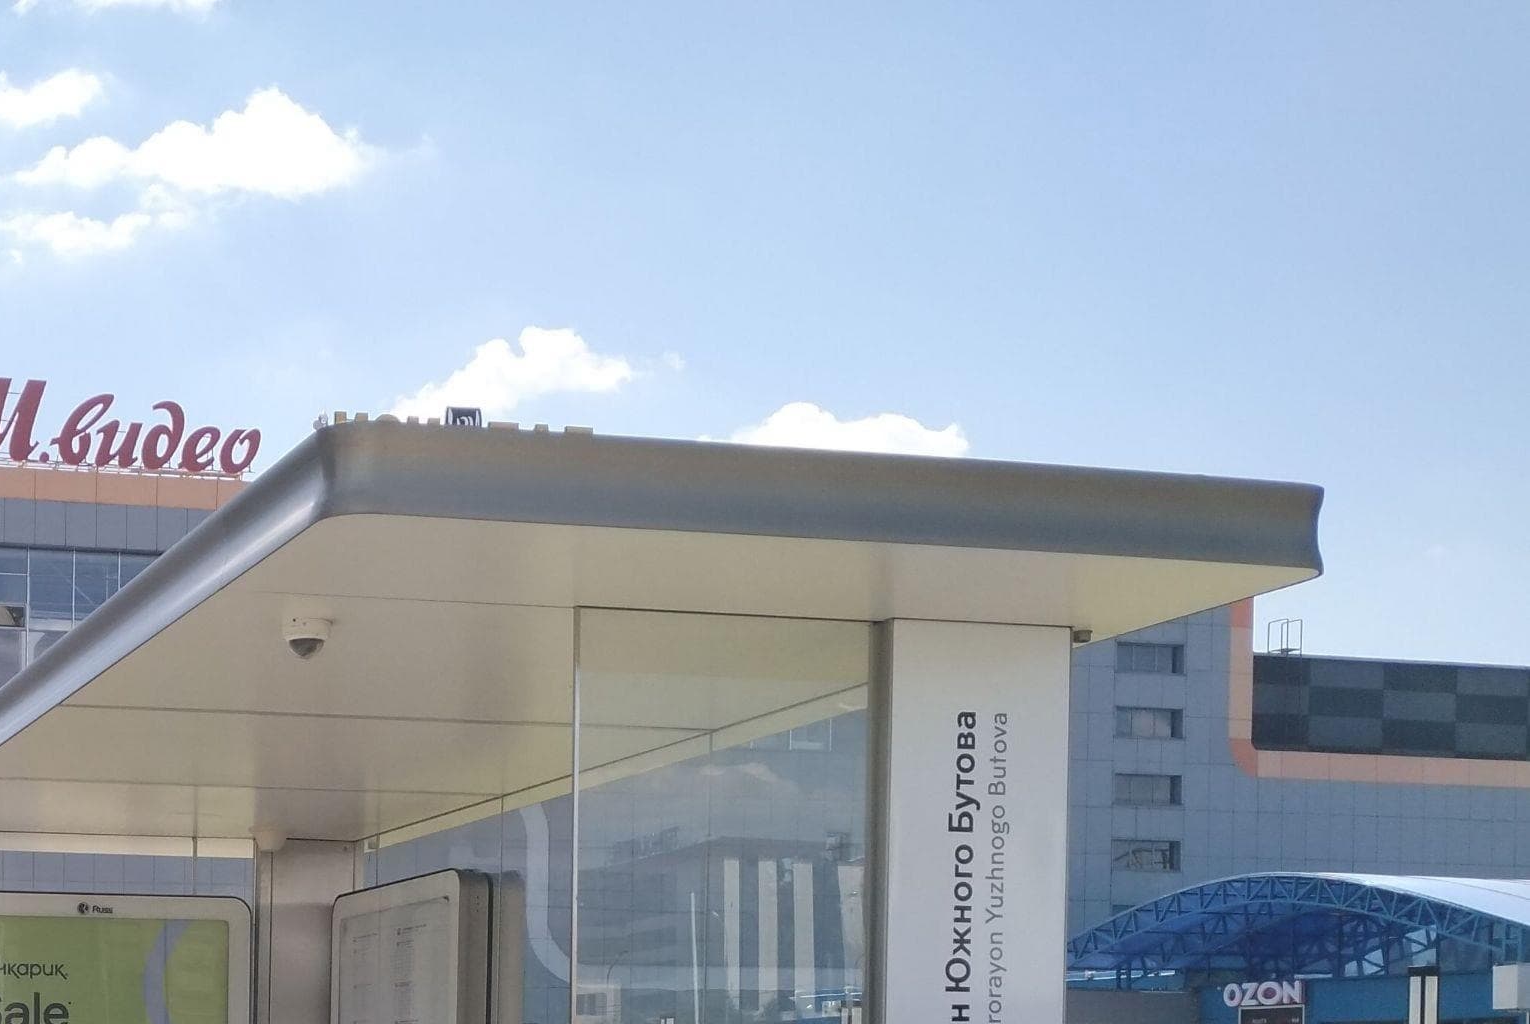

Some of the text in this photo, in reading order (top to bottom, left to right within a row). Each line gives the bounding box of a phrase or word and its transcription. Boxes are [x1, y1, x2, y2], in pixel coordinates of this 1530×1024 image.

[948, 711, 981, 833] Бутова
[988, 712, 1008, 796] Butova
[945, 844, 974, 992] Южного
[985, 805, 1010, 924] Yuzhnogo
[1223, 981, 1304, 1007] OZON
